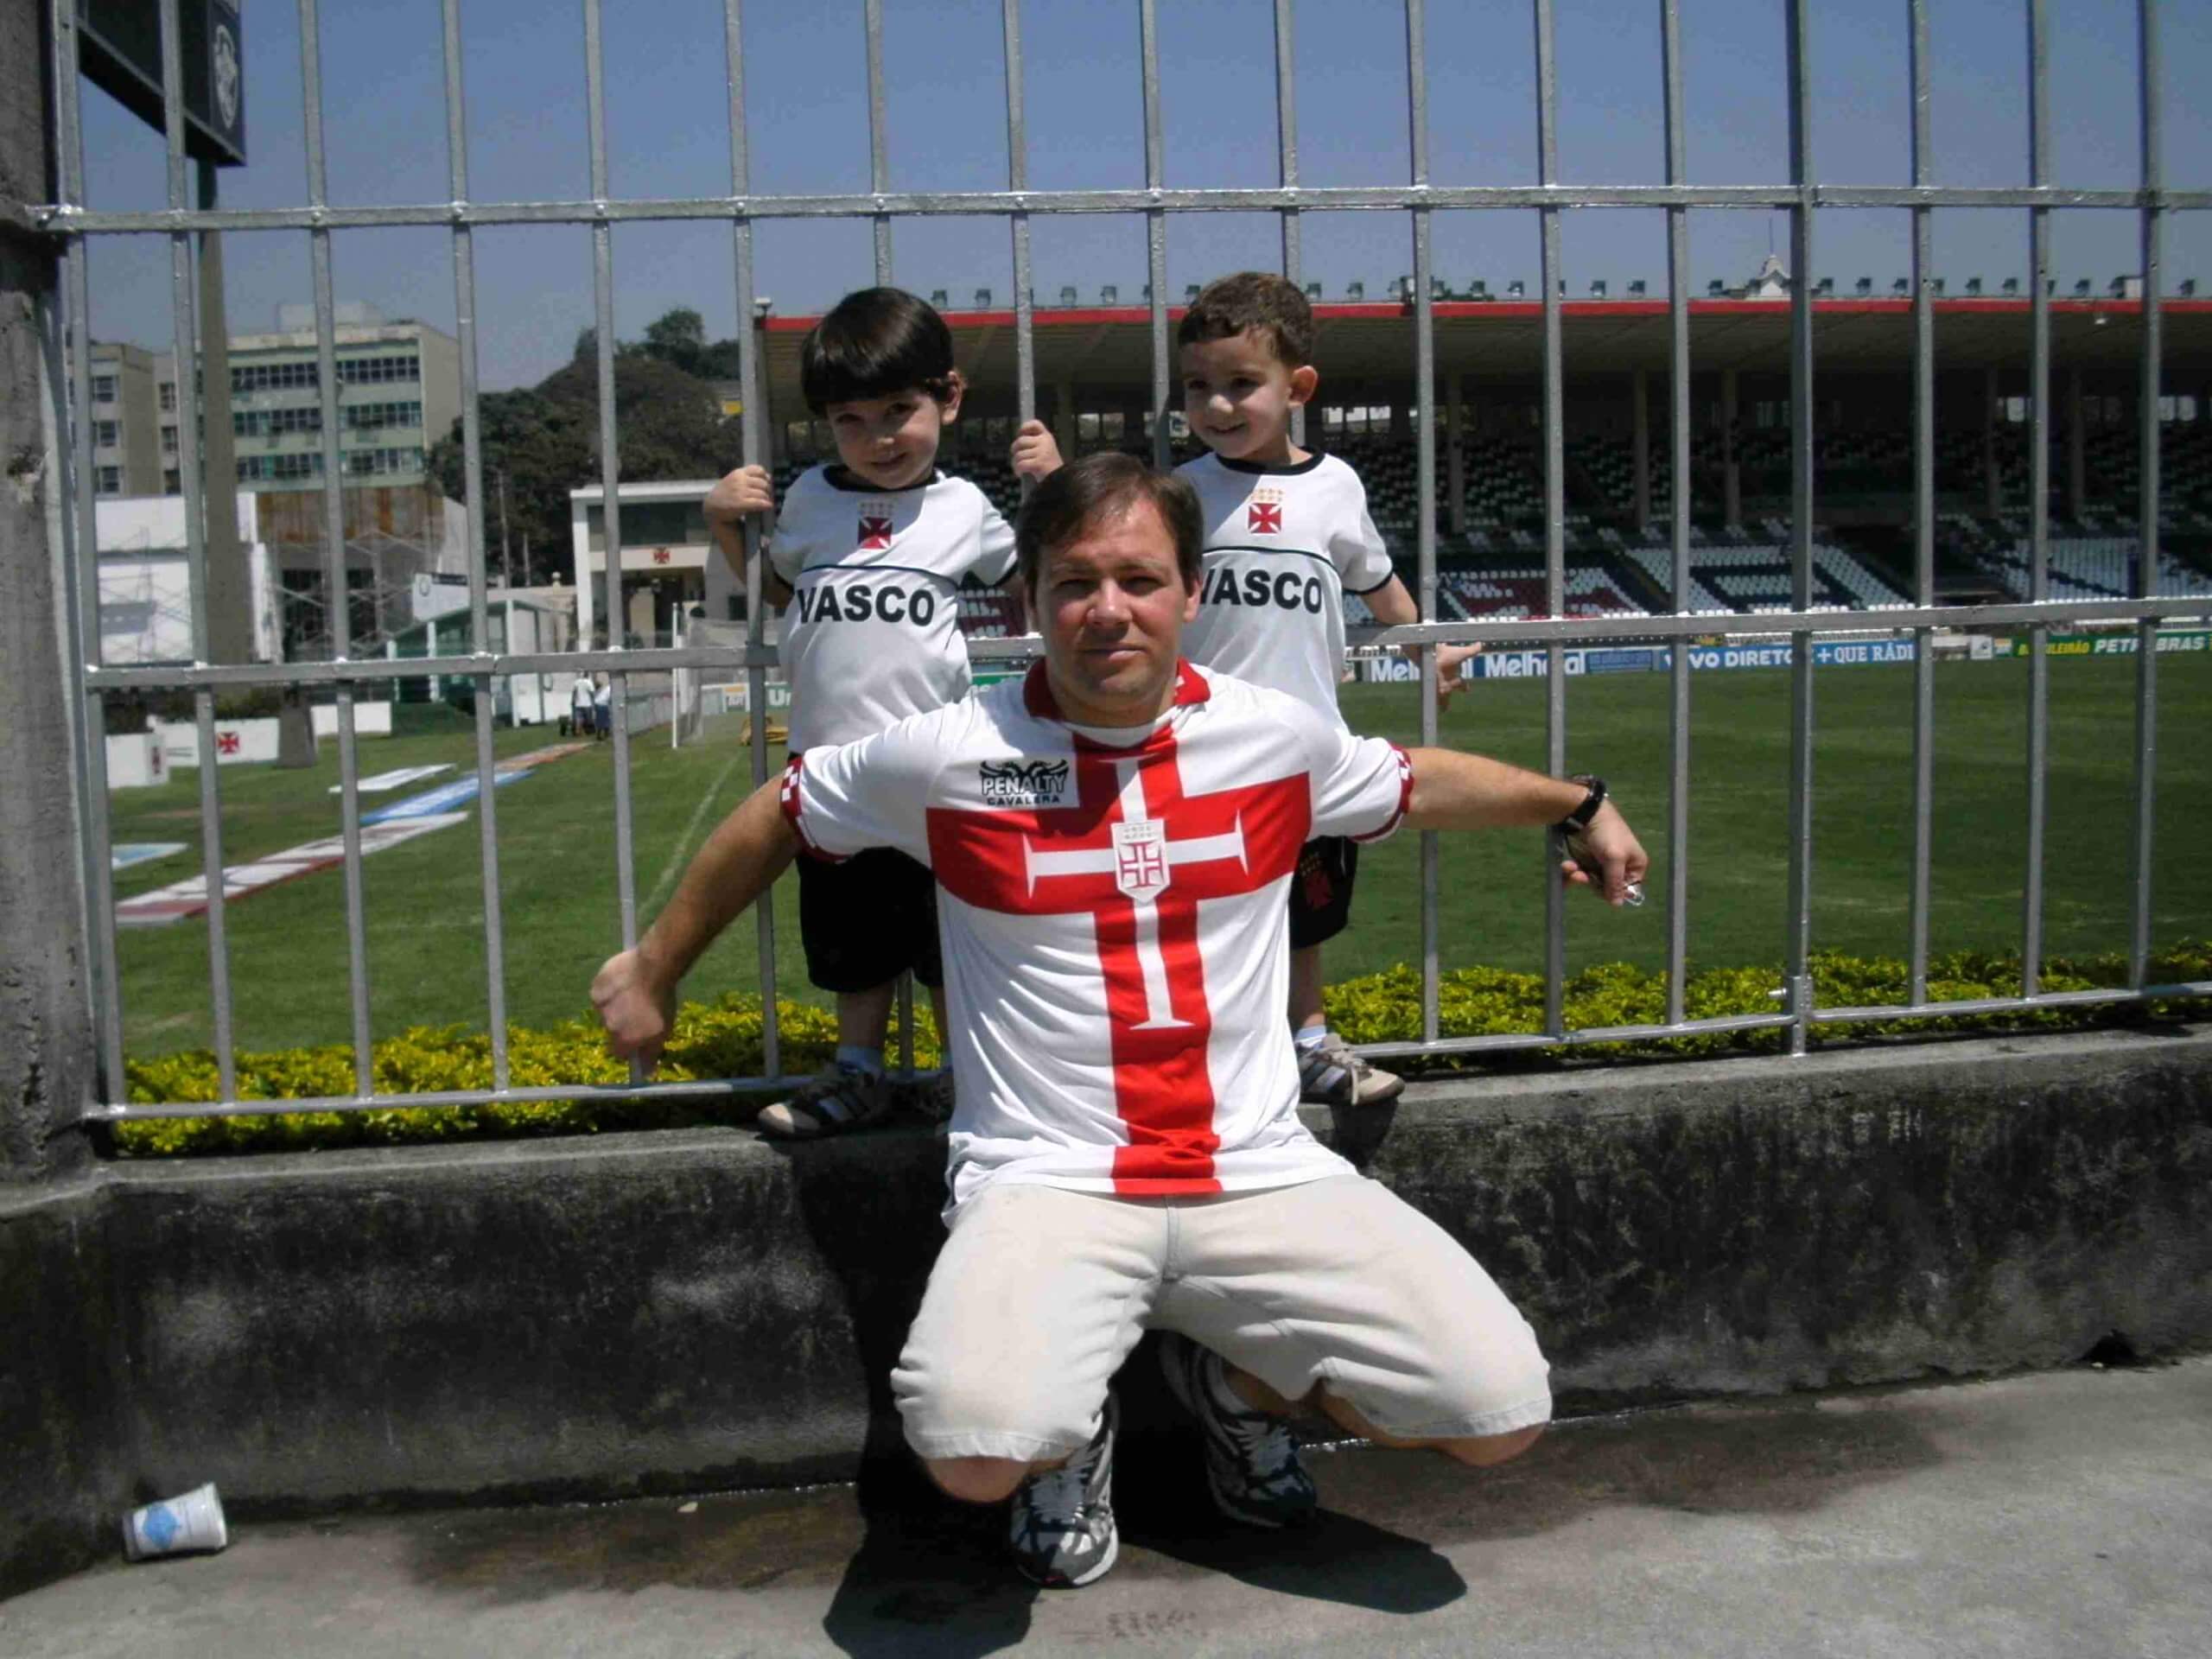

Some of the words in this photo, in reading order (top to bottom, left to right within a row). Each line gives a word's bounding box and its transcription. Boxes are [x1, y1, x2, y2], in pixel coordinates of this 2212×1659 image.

[797, 585, 935, 627] VASCO
[1834, 645, 1868, 664] QUE
[1872, 642, 1915, 661] RÁDI
[2094, 636, 2205, 653] PETBRAS
[1484, 650, 1586, 678] Melhal
[982, 774, 1065, 796] PENALTY
[987, 795, 1060, 806] CAVALERA
